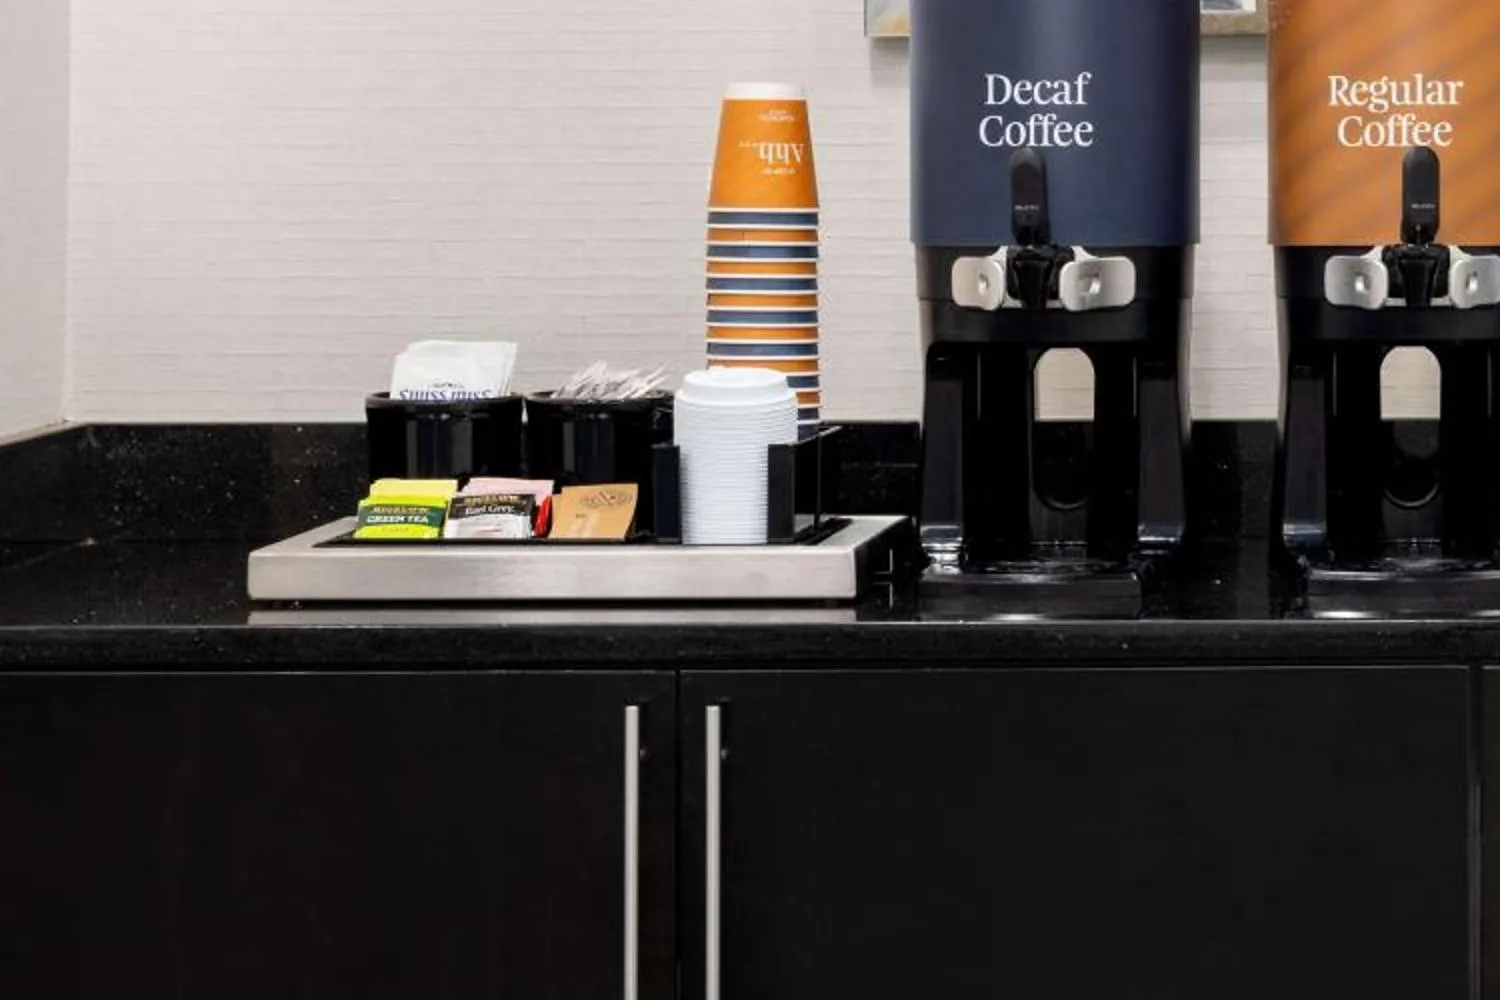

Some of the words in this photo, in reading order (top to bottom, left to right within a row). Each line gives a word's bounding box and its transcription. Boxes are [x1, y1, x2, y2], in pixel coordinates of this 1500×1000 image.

[984, 71, 1092, 105] Decaf
[1327, 73, 1464, 113] Regular
[979, 113, 1094, 147] Coffee
[1338, 112, 1453, 147] Coffee
